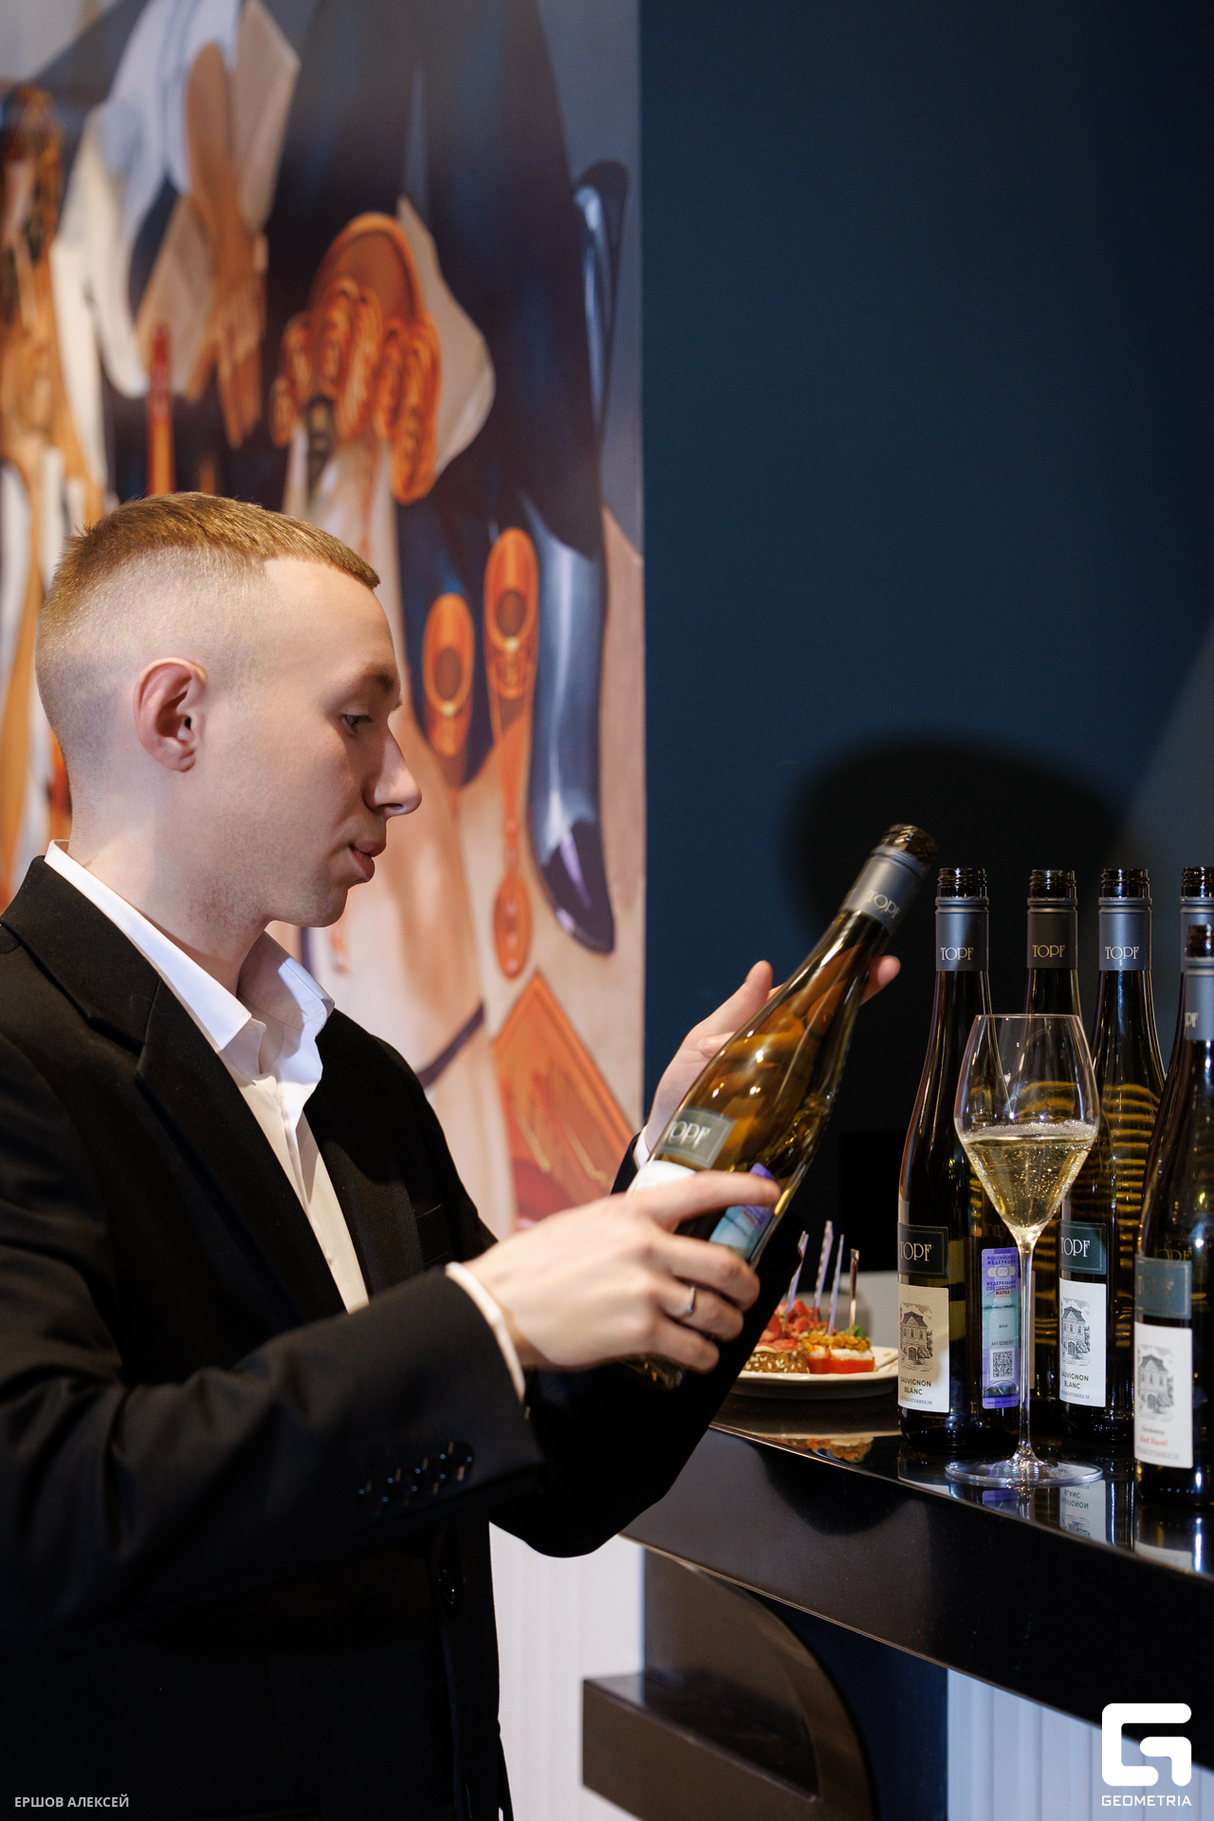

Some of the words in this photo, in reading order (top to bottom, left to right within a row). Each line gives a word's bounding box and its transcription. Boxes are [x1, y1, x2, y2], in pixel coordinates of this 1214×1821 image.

[940, 946, 974, 961] TOPF
[1032, 944, 1066, 958] TOPF
[1104, 945, 1140, 960] TOPF
[900, 1376, 932, 1388] SAUVIGNON
[1064, 1380, 1081, 1390] BLANC
[904, 1386, 923, 1396] BLANC
